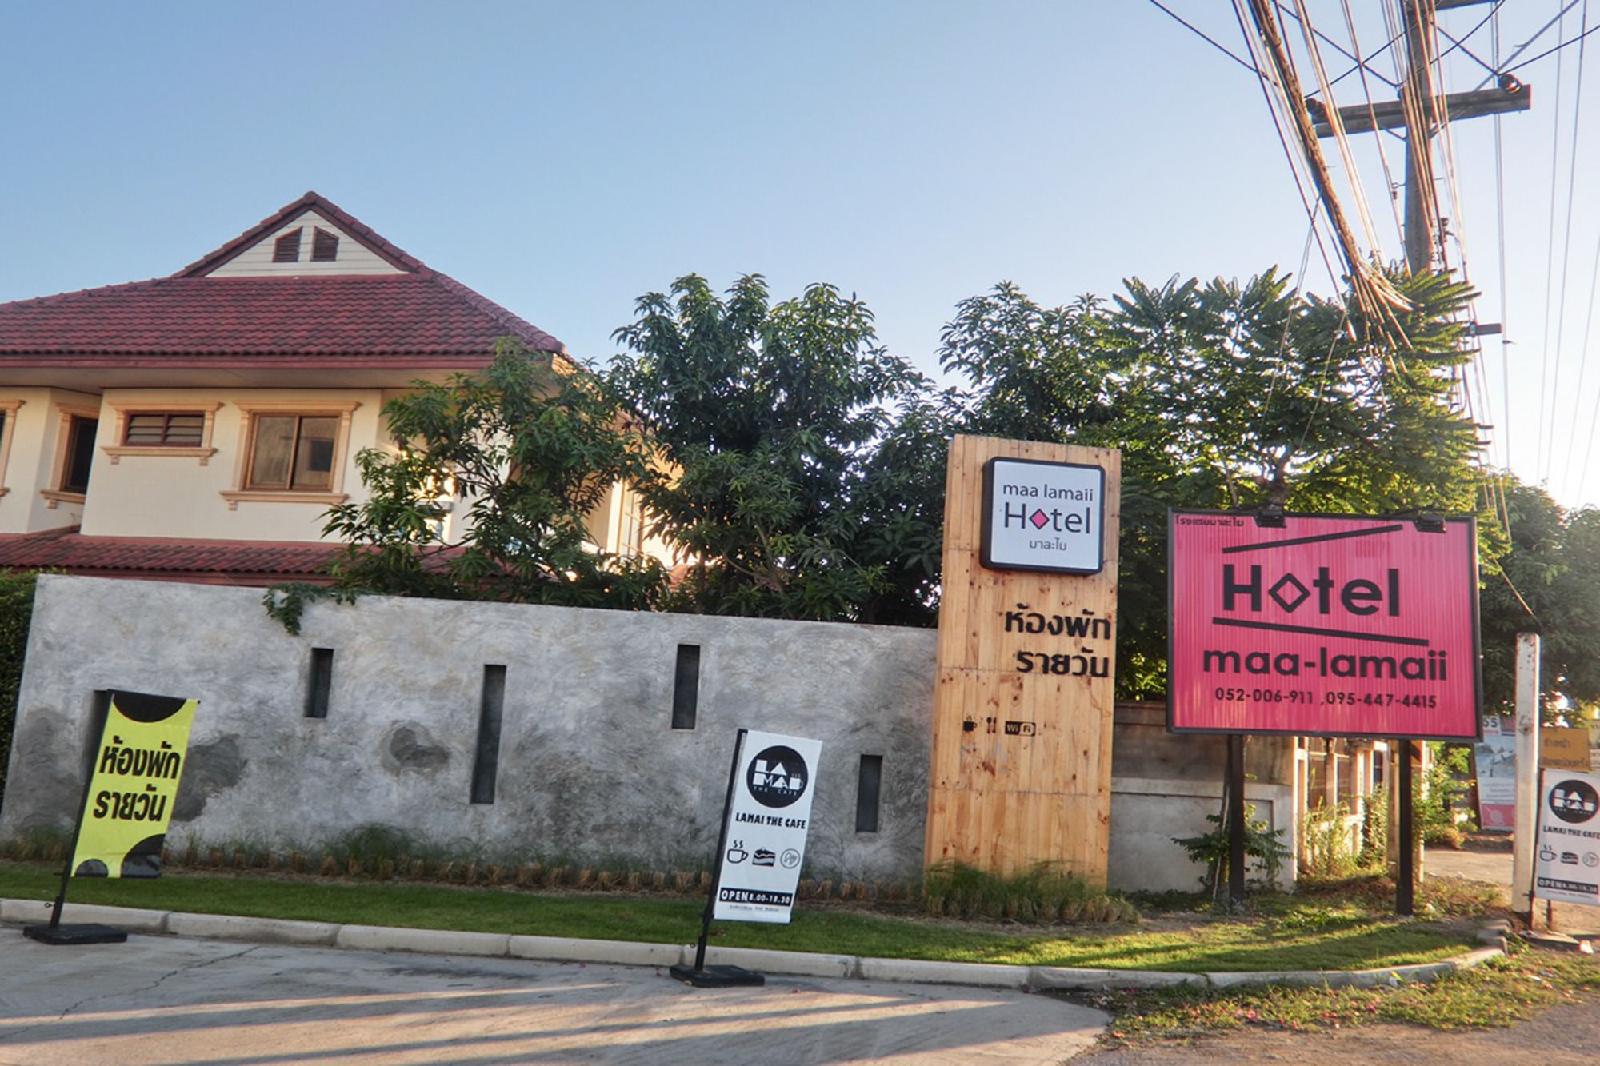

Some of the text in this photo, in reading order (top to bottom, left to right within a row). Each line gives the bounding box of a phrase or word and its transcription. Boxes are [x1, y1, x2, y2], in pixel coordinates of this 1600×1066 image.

[1003, 484, 1094, 502] maa lamaii
[1004, 502, 1091, 534] Hotel
[1222, 564, 1400, 617] Hotel
[1005, 603, 1111, 640] ห้องพัก
[1016, 646, 1110, 677] รายวัน
[1203, 647, 1448, 681] maa-lamaii
[1214, 687, 1314, 704] 052-006-911
[99, 735, 181, 779] ห้องพัก
[93, 784, 166, 822] รายวัน
[735, 812, 807, 829] LAMAI THE CAFE
[721, 890, 749, 901] OPEN
